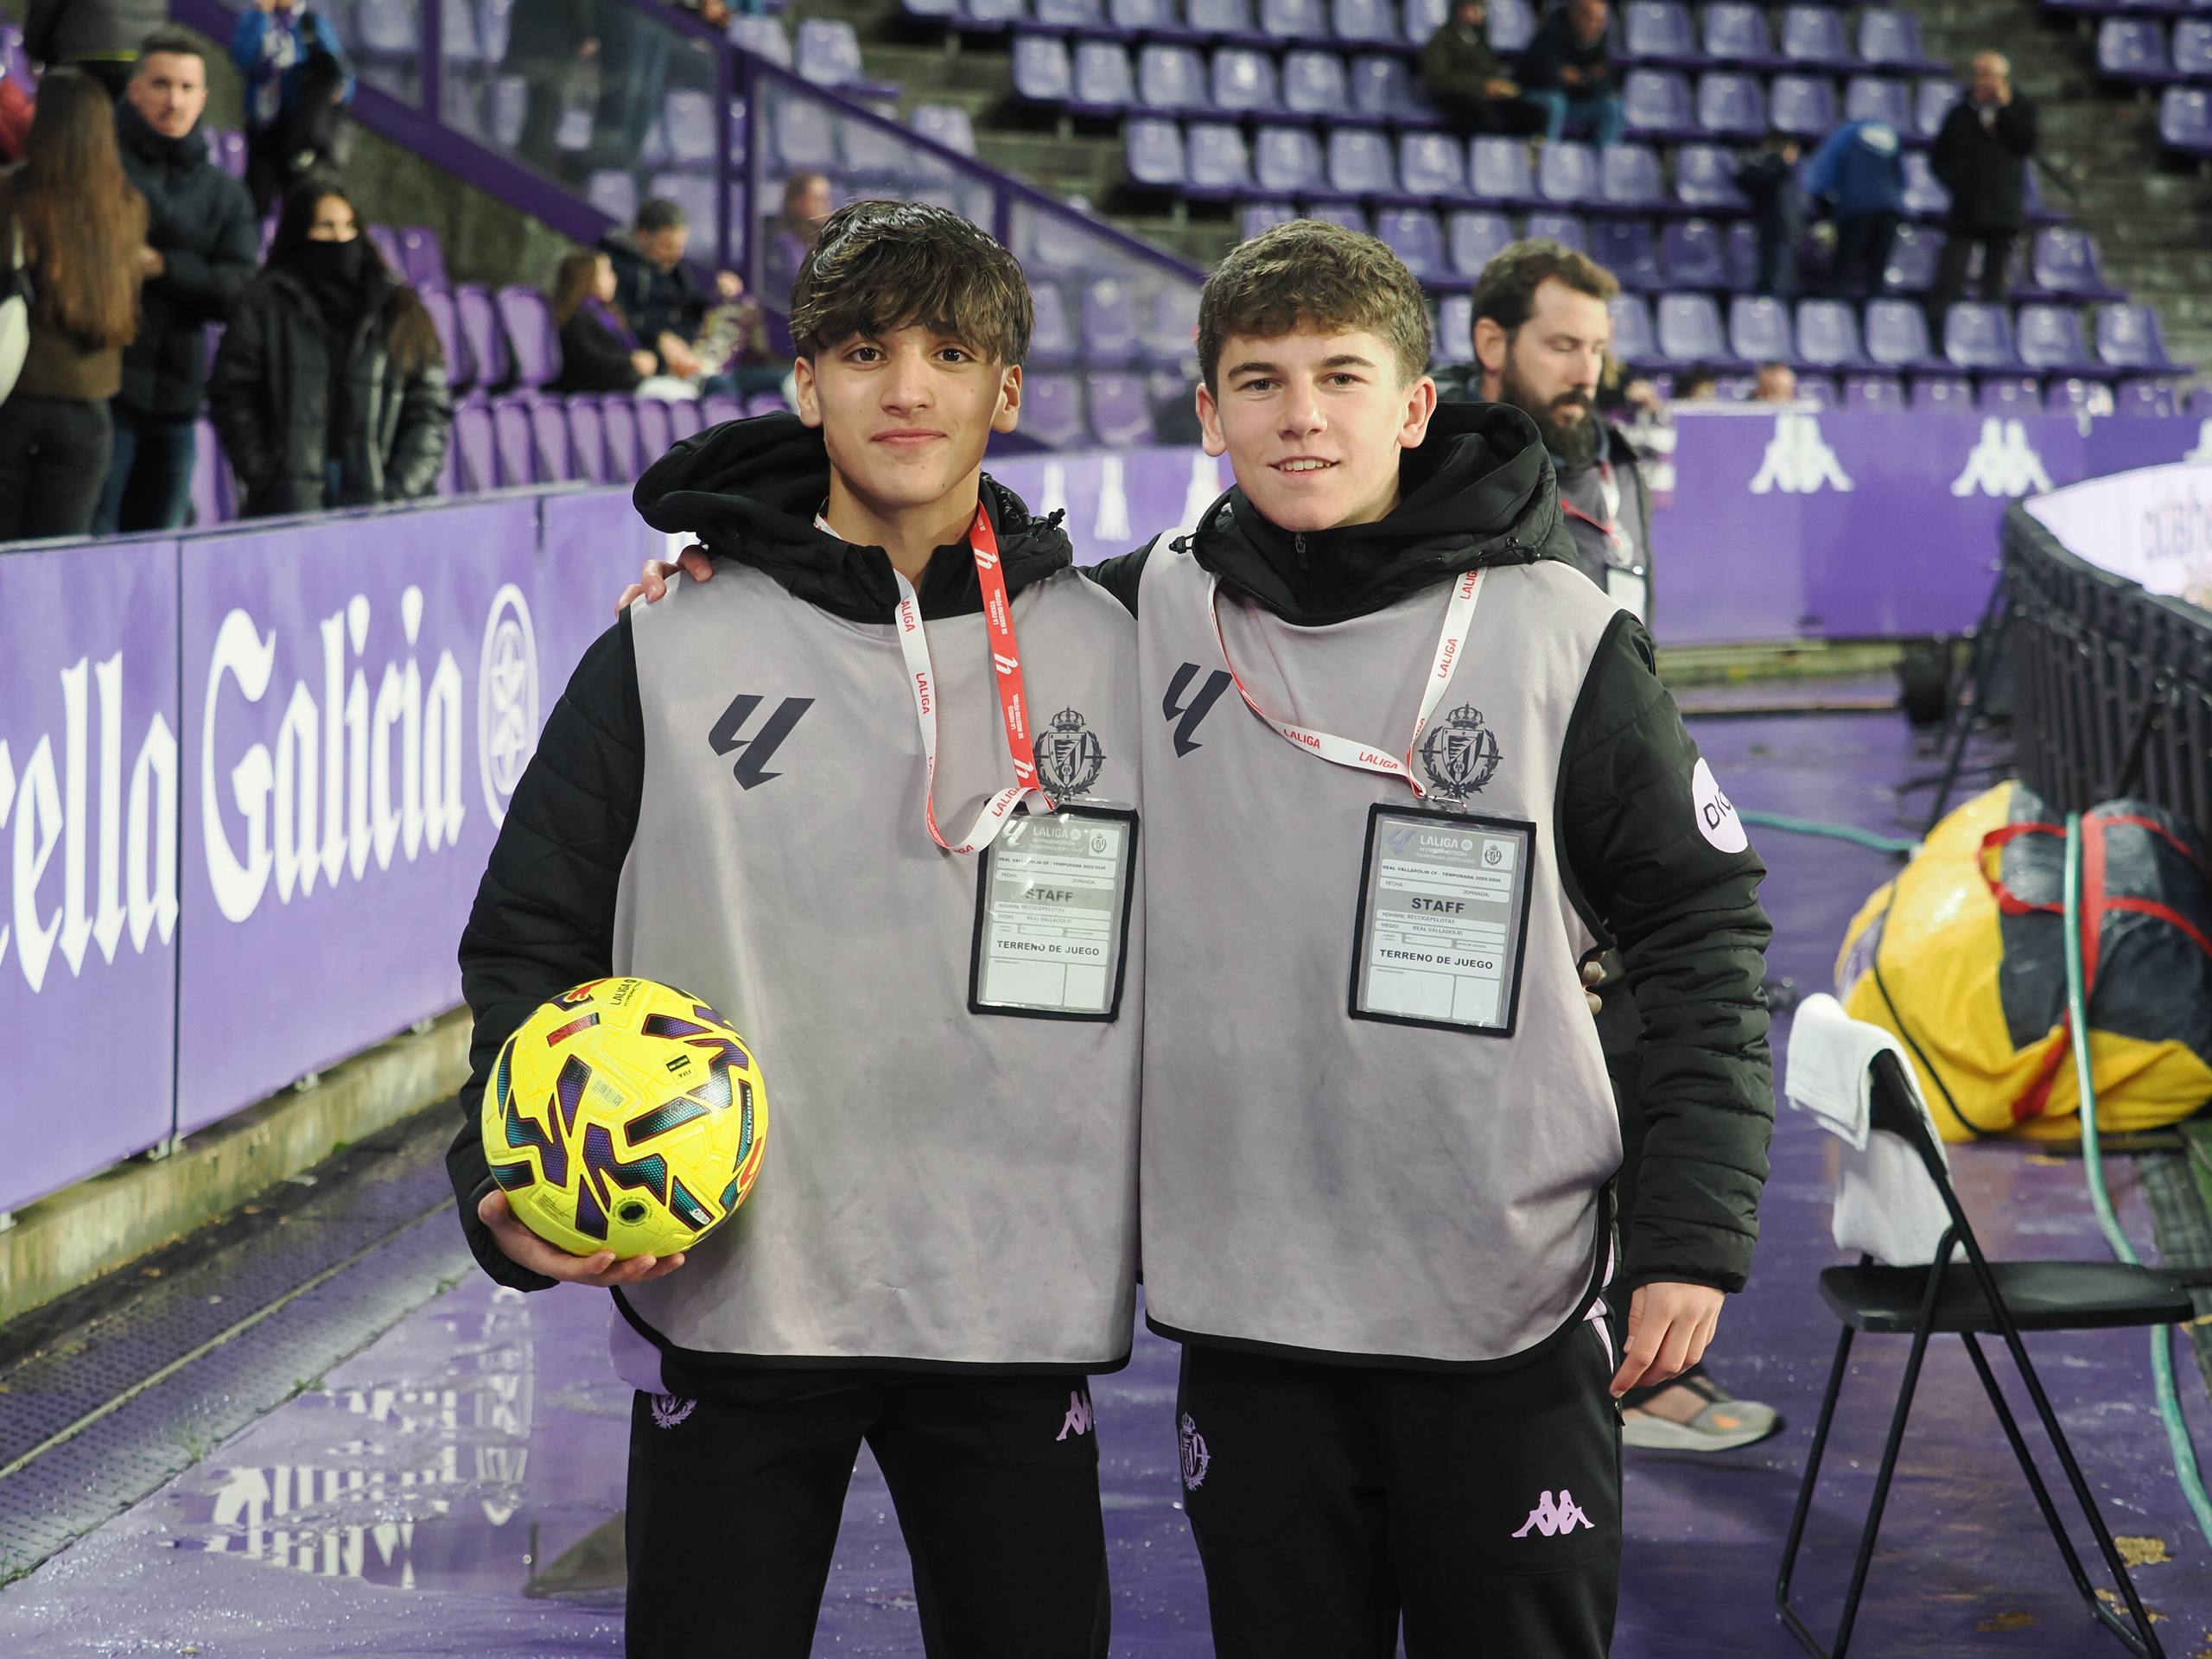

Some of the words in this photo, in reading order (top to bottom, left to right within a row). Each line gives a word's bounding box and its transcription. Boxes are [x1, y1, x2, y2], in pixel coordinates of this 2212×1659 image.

[1438, 639, 1458, 678] LALIGA
[916, 672, 930, 715] LALIGA
[1283, 728, 1321, 749] LALIGA
[201, 584, 466, 923] Galicia
[1358, 752, 1398, 770] LALIGA
[1033, 826, 1068, 838] LALIGA
[1420, 835, 1459, 849] LALIGA
[1397, 867, 1430, 875] VALLADOLID
[1442, 872, 1474, 880] TEMPORADA
[1026, 888, 1074, 902] STAFF
[1411, 897, 1465, 914] STAFF
[1407, 914, 1455, 925] RECOGEPELOTAS
[1427, 927, 1464, 936] VALLADOLID
[997, 940, 1046, 952] TERRENO
[1048, 944, 1062, 953] DE
[1065, 946, 1100, 957] JUEGO
[1380, 949, 1433, 963] TERRENO
[1436, 956, 1451, 964] DE
[1454, 958, 1493, 969] JUEGO
[610, 983, 631, 1006] LALIGA
